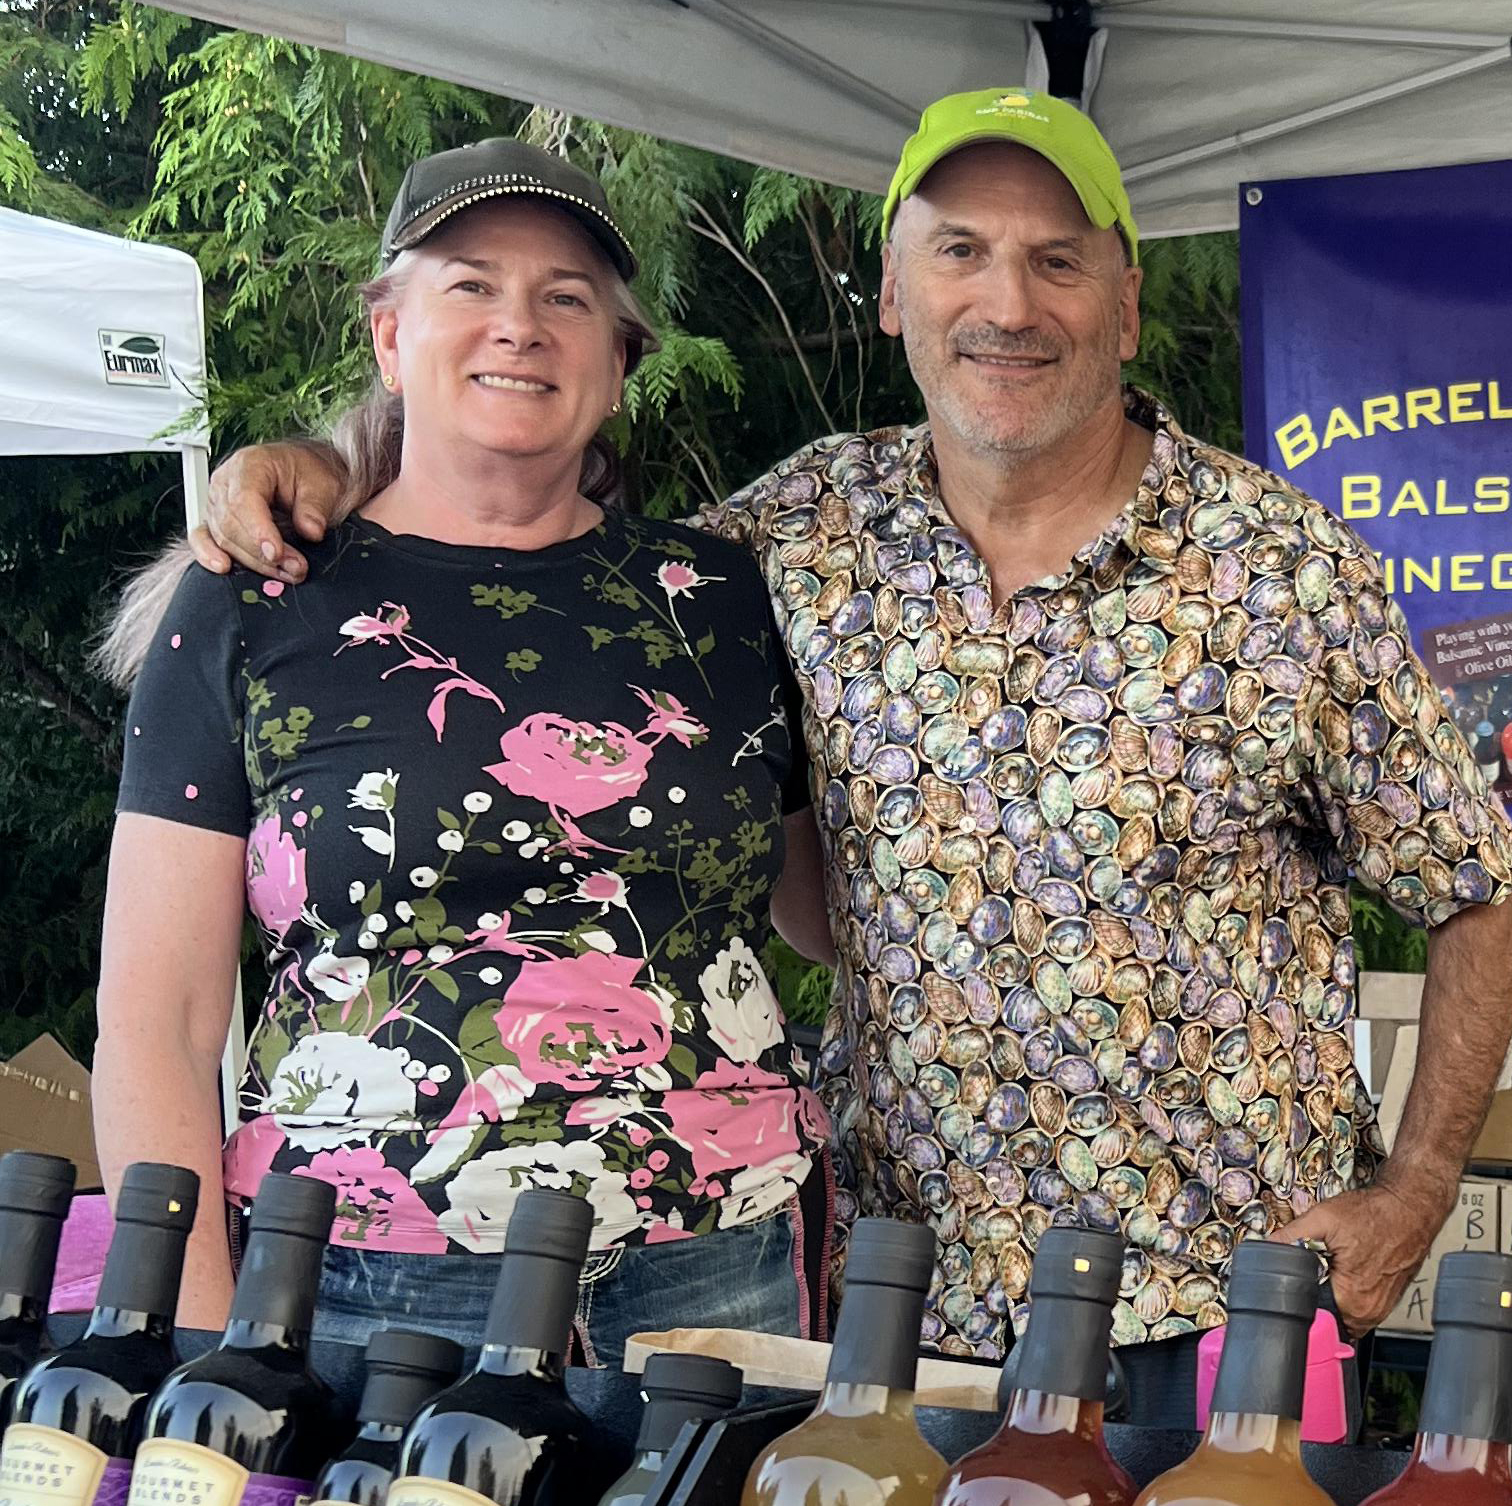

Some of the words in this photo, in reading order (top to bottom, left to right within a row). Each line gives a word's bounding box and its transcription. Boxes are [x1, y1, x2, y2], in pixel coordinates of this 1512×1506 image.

[104, 350, 161, 375] Eurmax
[1435, 628, 1476, 647] Playing
[1465, 662, 1494, 675] Olive
